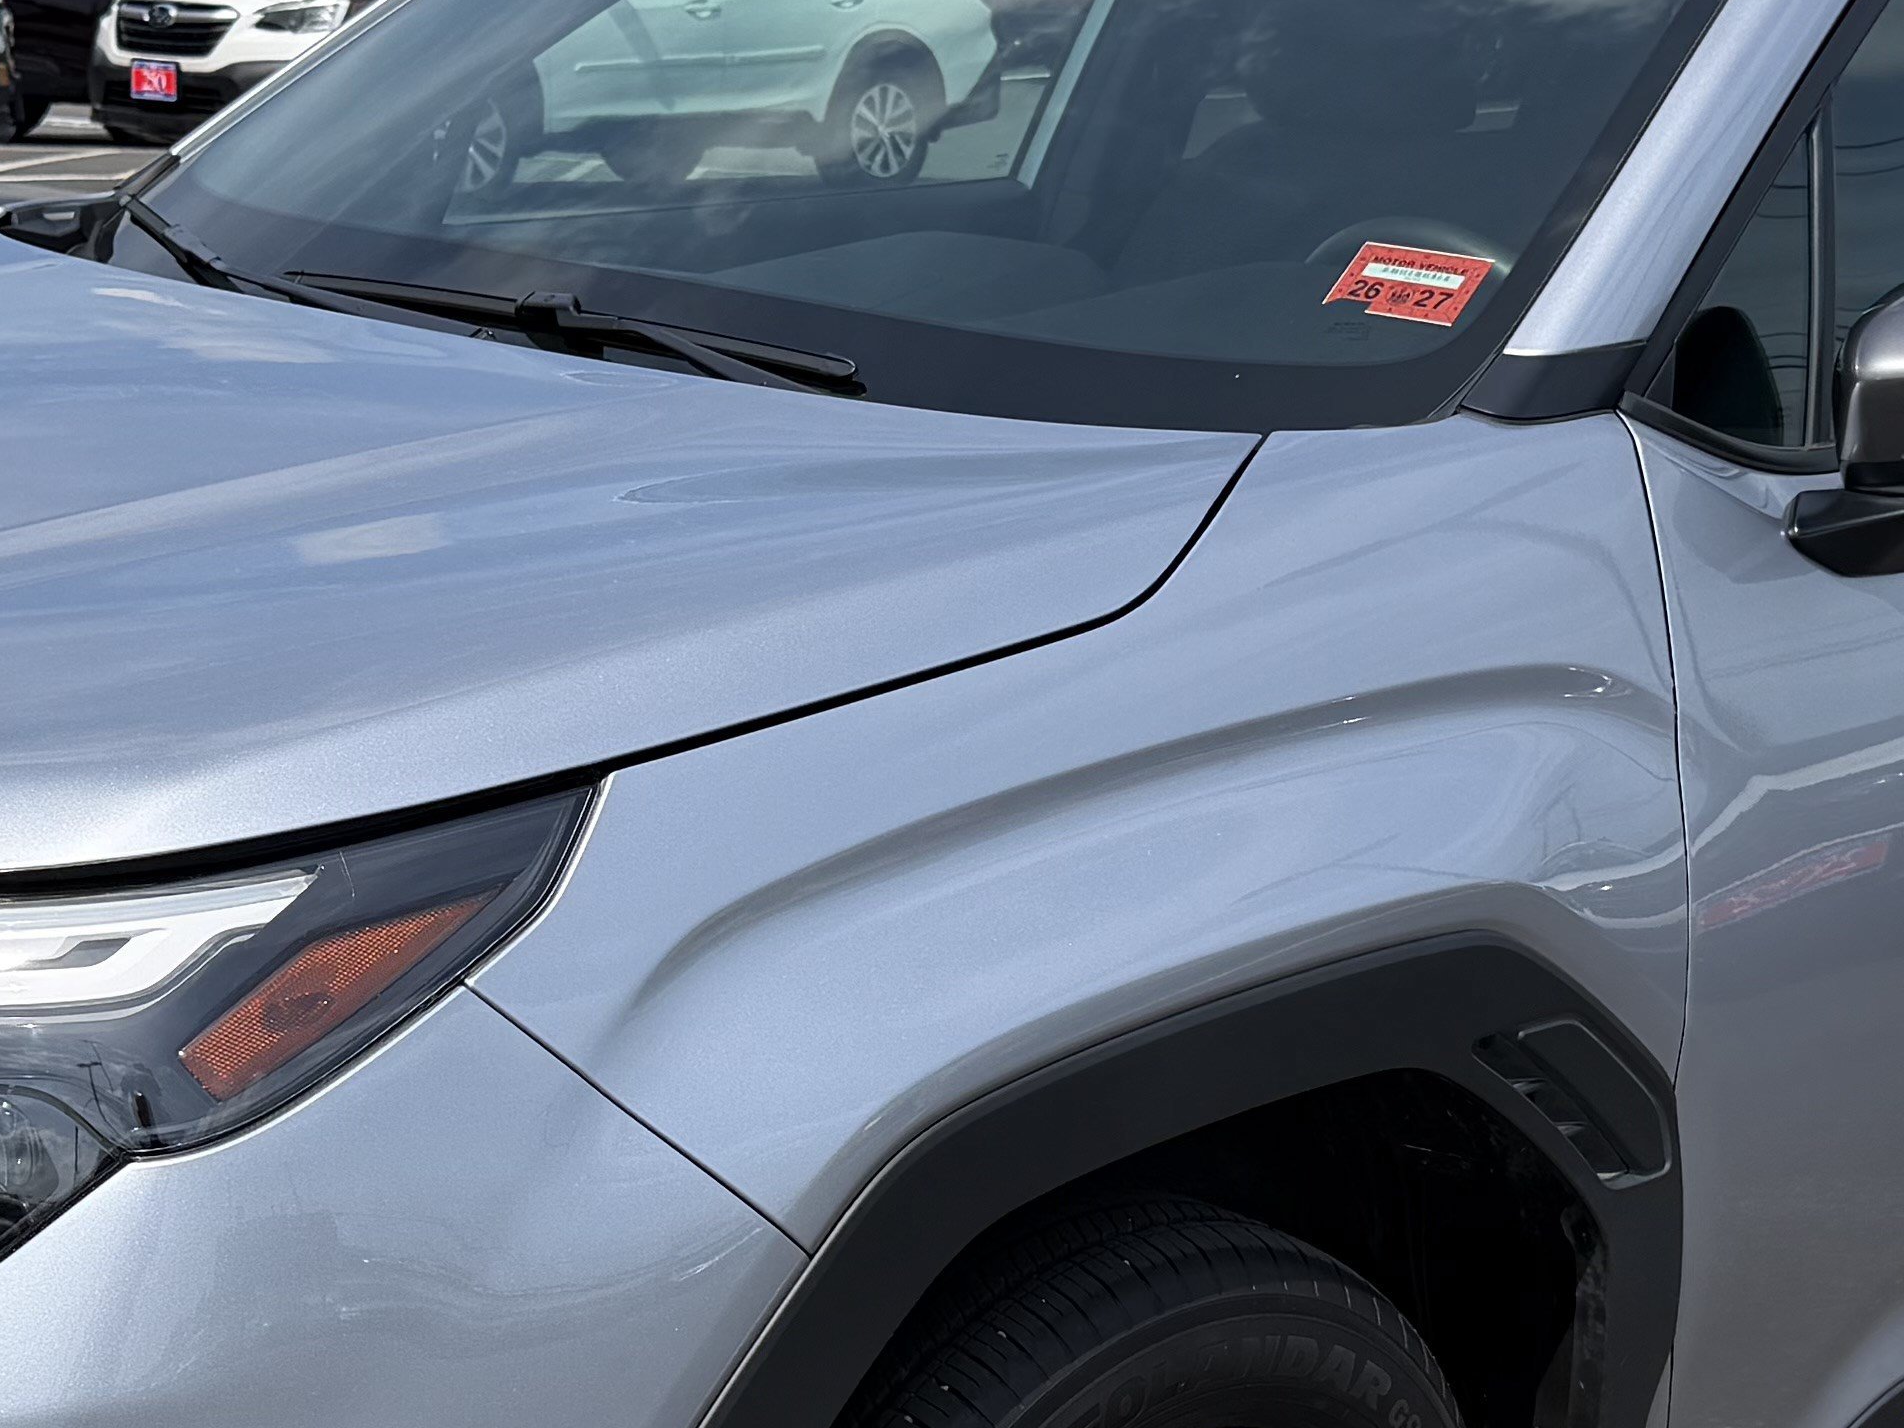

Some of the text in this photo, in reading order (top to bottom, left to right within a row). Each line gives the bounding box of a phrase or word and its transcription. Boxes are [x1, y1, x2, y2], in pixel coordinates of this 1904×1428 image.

[1372, 255, 1470, 275] MOTOR VEHICLE
[1347, 279, 1454, 310] 26 27
